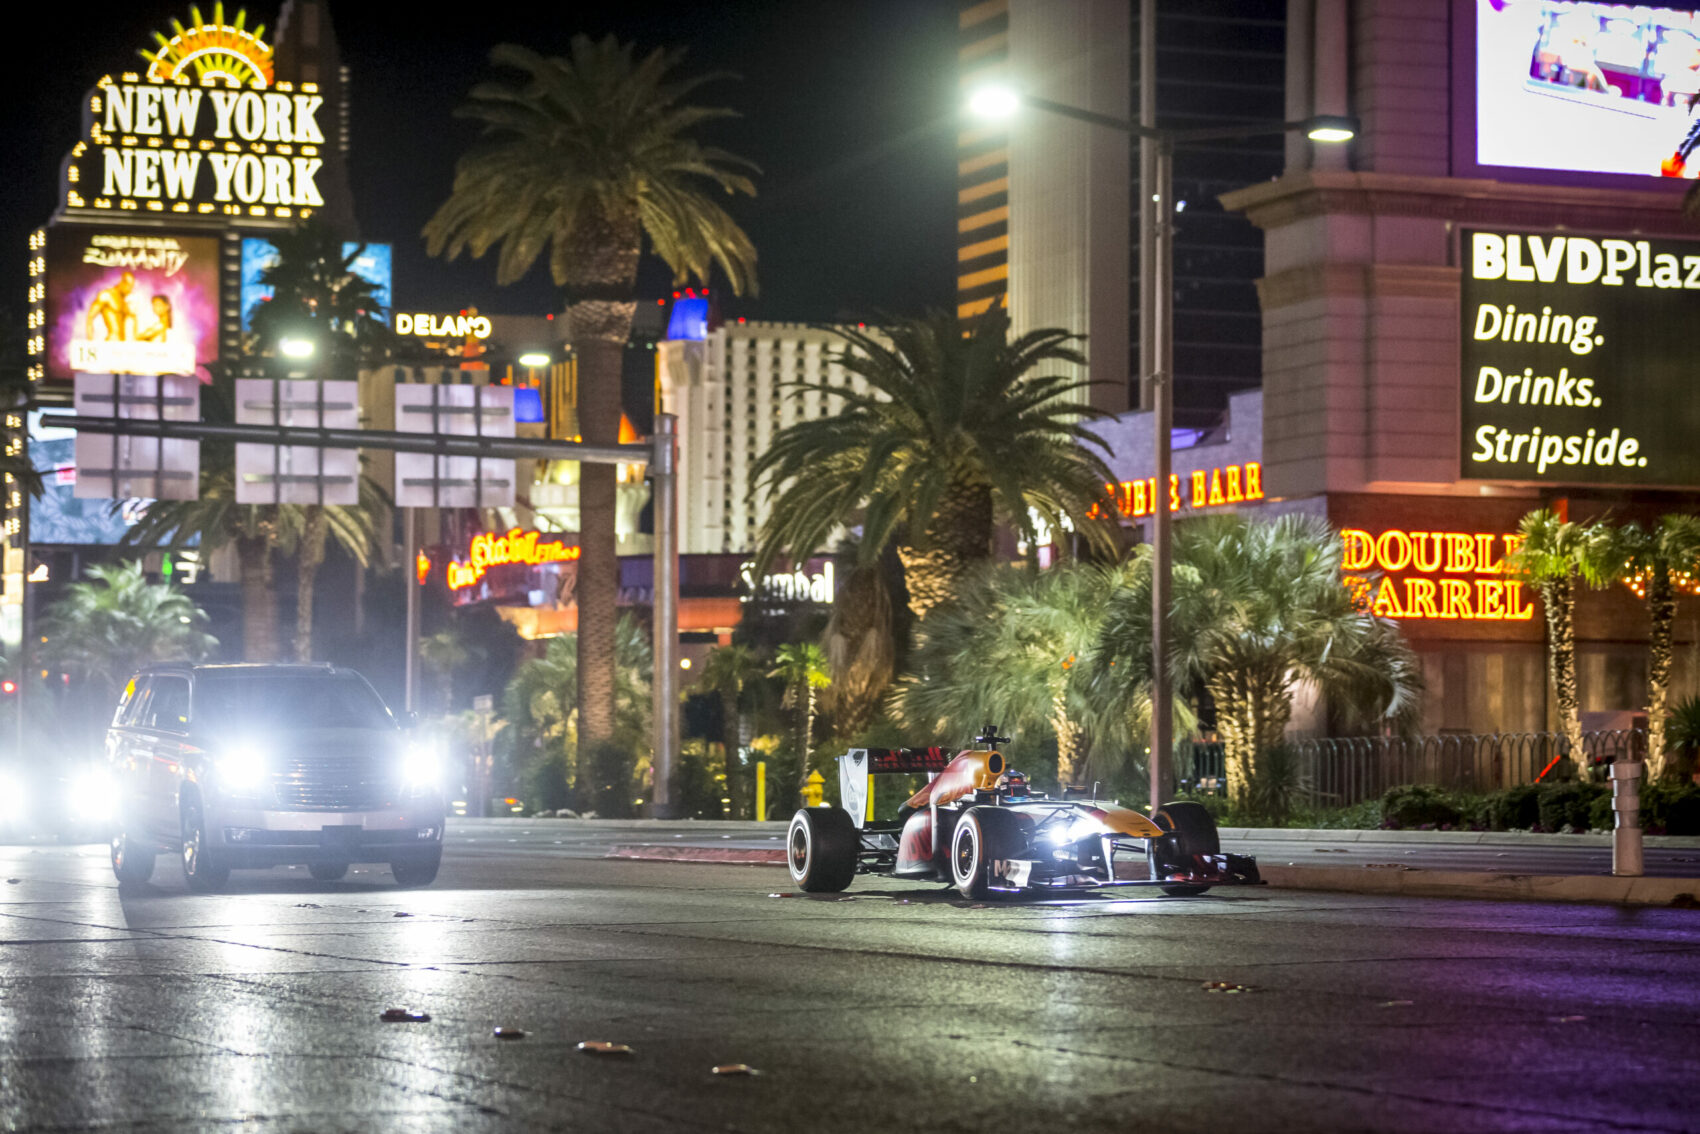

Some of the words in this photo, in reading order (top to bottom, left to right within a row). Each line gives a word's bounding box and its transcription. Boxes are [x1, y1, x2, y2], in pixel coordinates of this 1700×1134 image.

[103, 85, 203, 136] NEW
[208, 91, 325, 144] YORK
[102, 148, 202, 199] NEW
[208, 153, 325, 206] YORK
[395, 313, 492, 339] DELANO
[1474, 304, 1605, 355] Dining.
[1474, 366, 1602, 407] Drinks.
[1472, 425, 1648, 474] Stripside.
